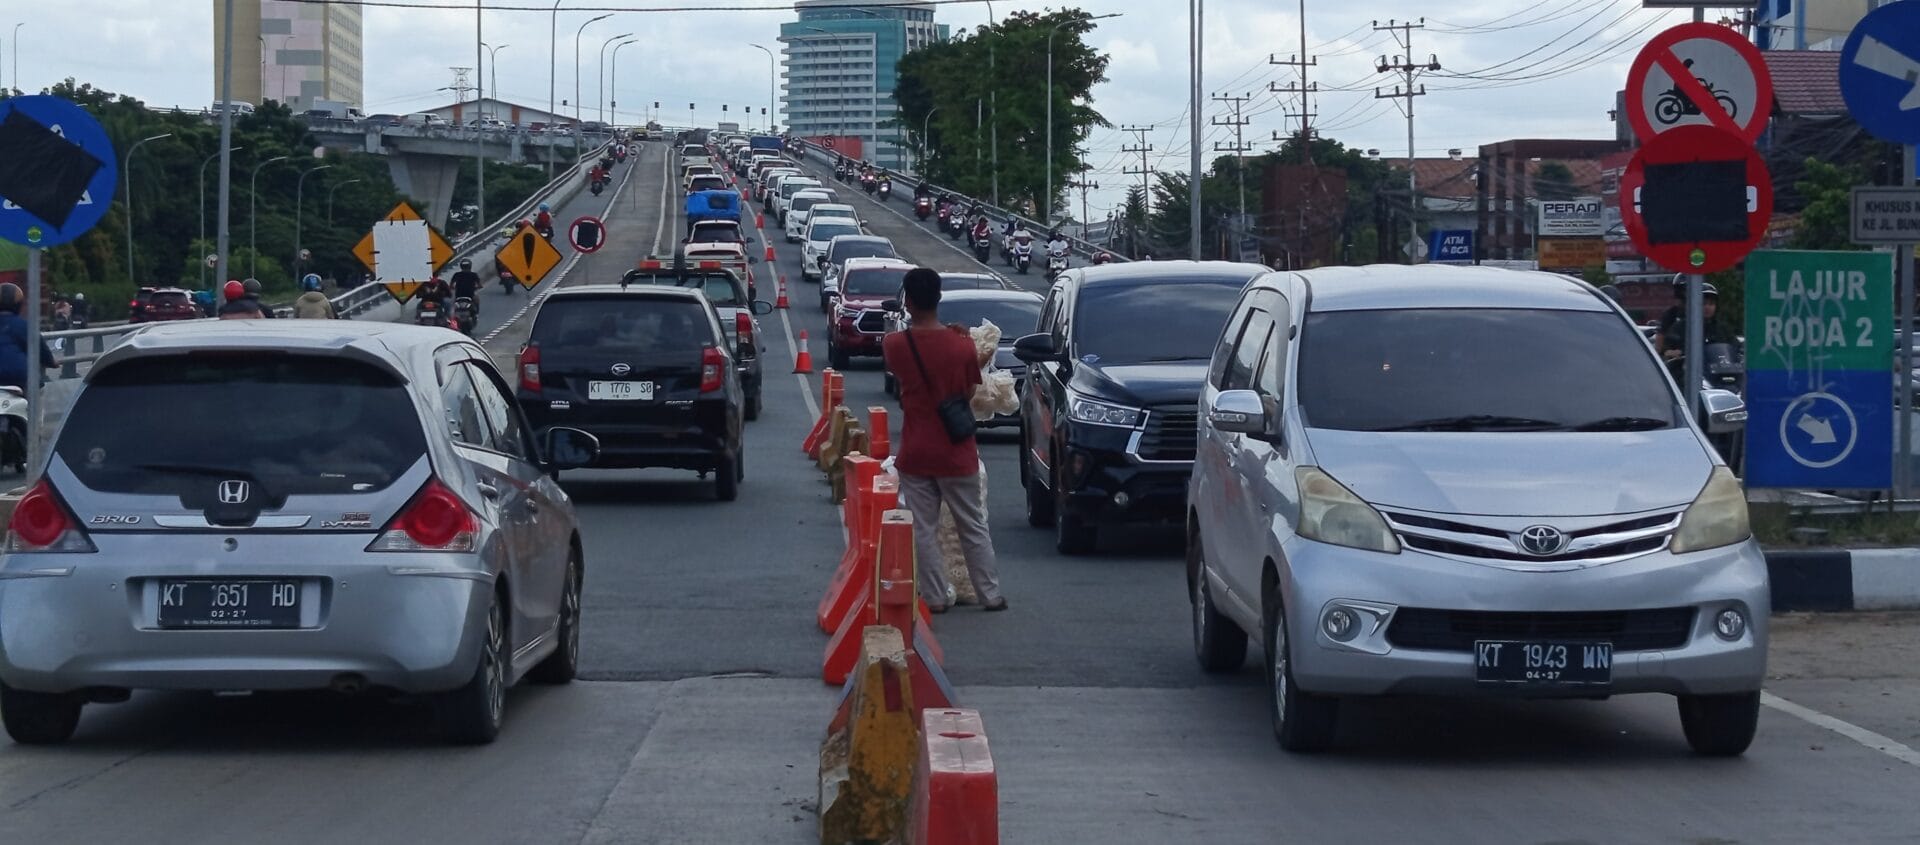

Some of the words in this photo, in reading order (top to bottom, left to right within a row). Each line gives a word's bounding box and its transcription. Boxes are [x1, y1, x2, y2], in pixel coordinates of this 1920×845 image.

[1544, 203, 1601, 213] PERADI
[1865, 201, 1911, 213] KHUSUS
[1862, 219, 1876, 230] KE
[1443, 236, 1465, 245] ATM
[1450, 246, 1469, 255] BCA
[1770, 269, 1867, 301] LAJUR
[1765, 315, 1847, 347] RODA
[1855, 316, 1873, 347] 2
[590, 382, 602, 393] KT
[610, 382, 631, 393] 1776
[90, 515, 141, 524] BRIO
[163, 584, 187, 606] KT
[272, 584, 295, 607] HD
[1479, 643, 1502, 667] KT
[1522, 644, 1567, 668] 1943
